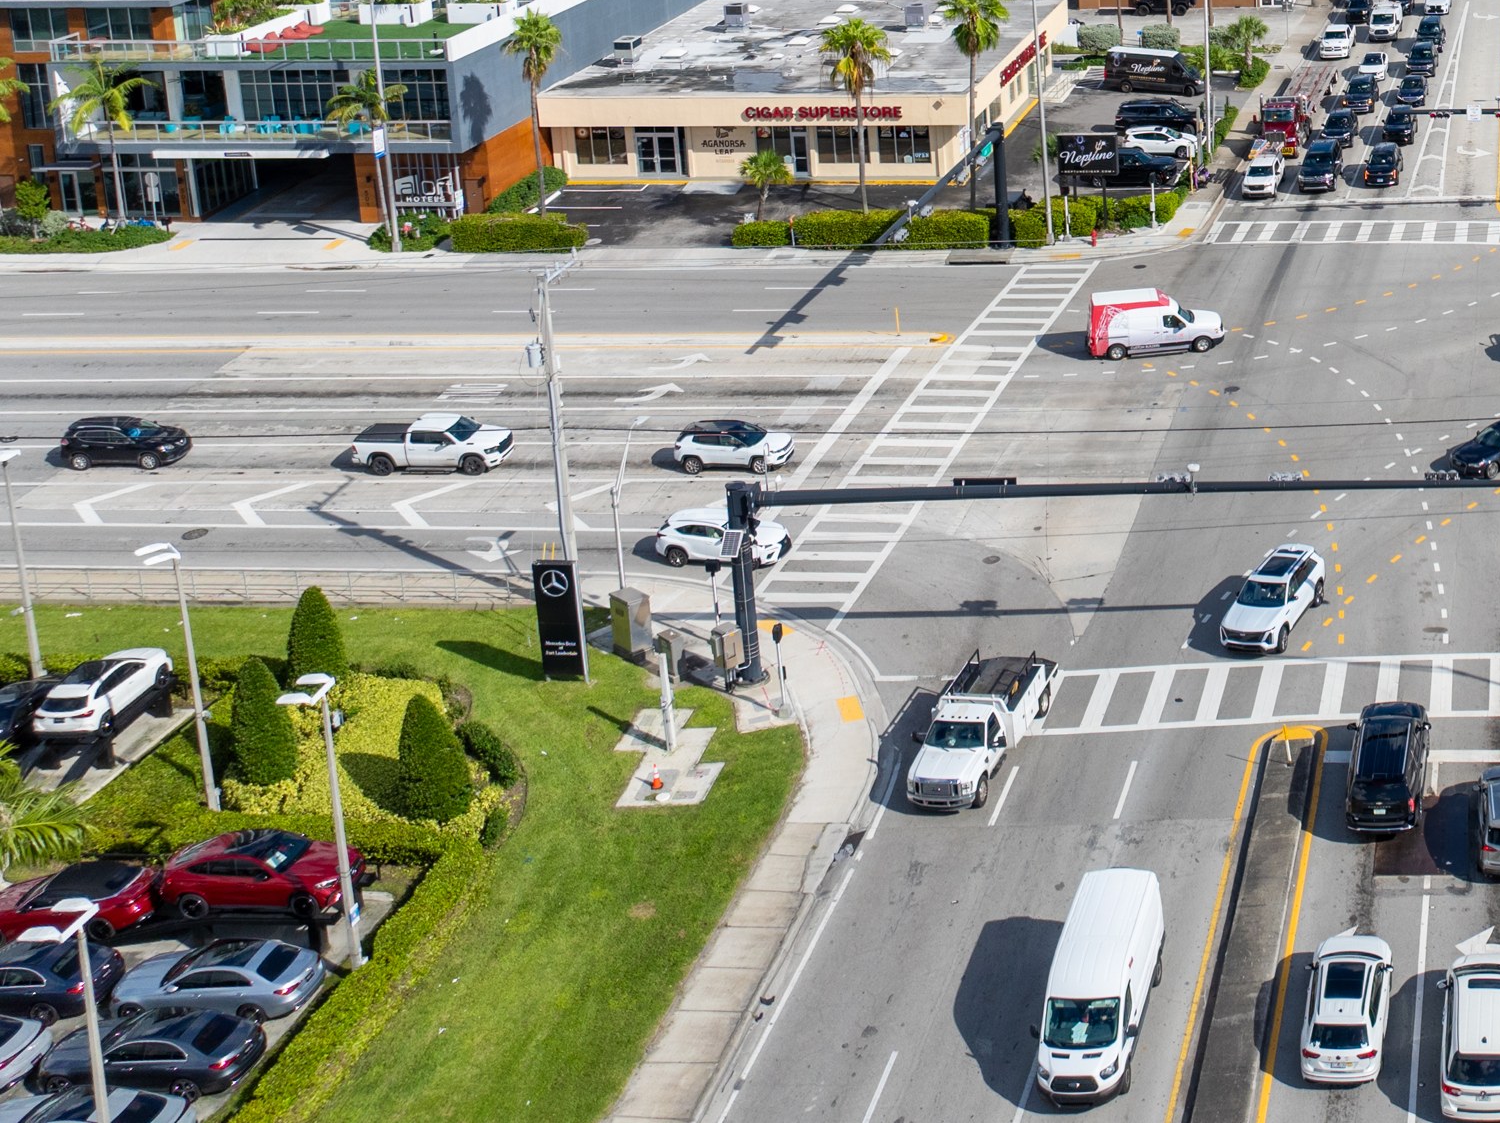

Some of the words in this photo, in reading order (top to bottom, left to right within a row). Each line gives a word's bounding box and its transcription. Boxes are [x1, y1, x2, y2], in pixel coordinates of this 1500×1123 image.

[1131, 63, 1165, 75] Neptune
[744, 106, 794, 119] CIGAR
[799, 106, 903, 119] SUPERSTORE
[701, 140, 746, 148] AGANORSA
[1060, 150, 1115, 168] Neptune
[395, 172, 453, 195] aloft
